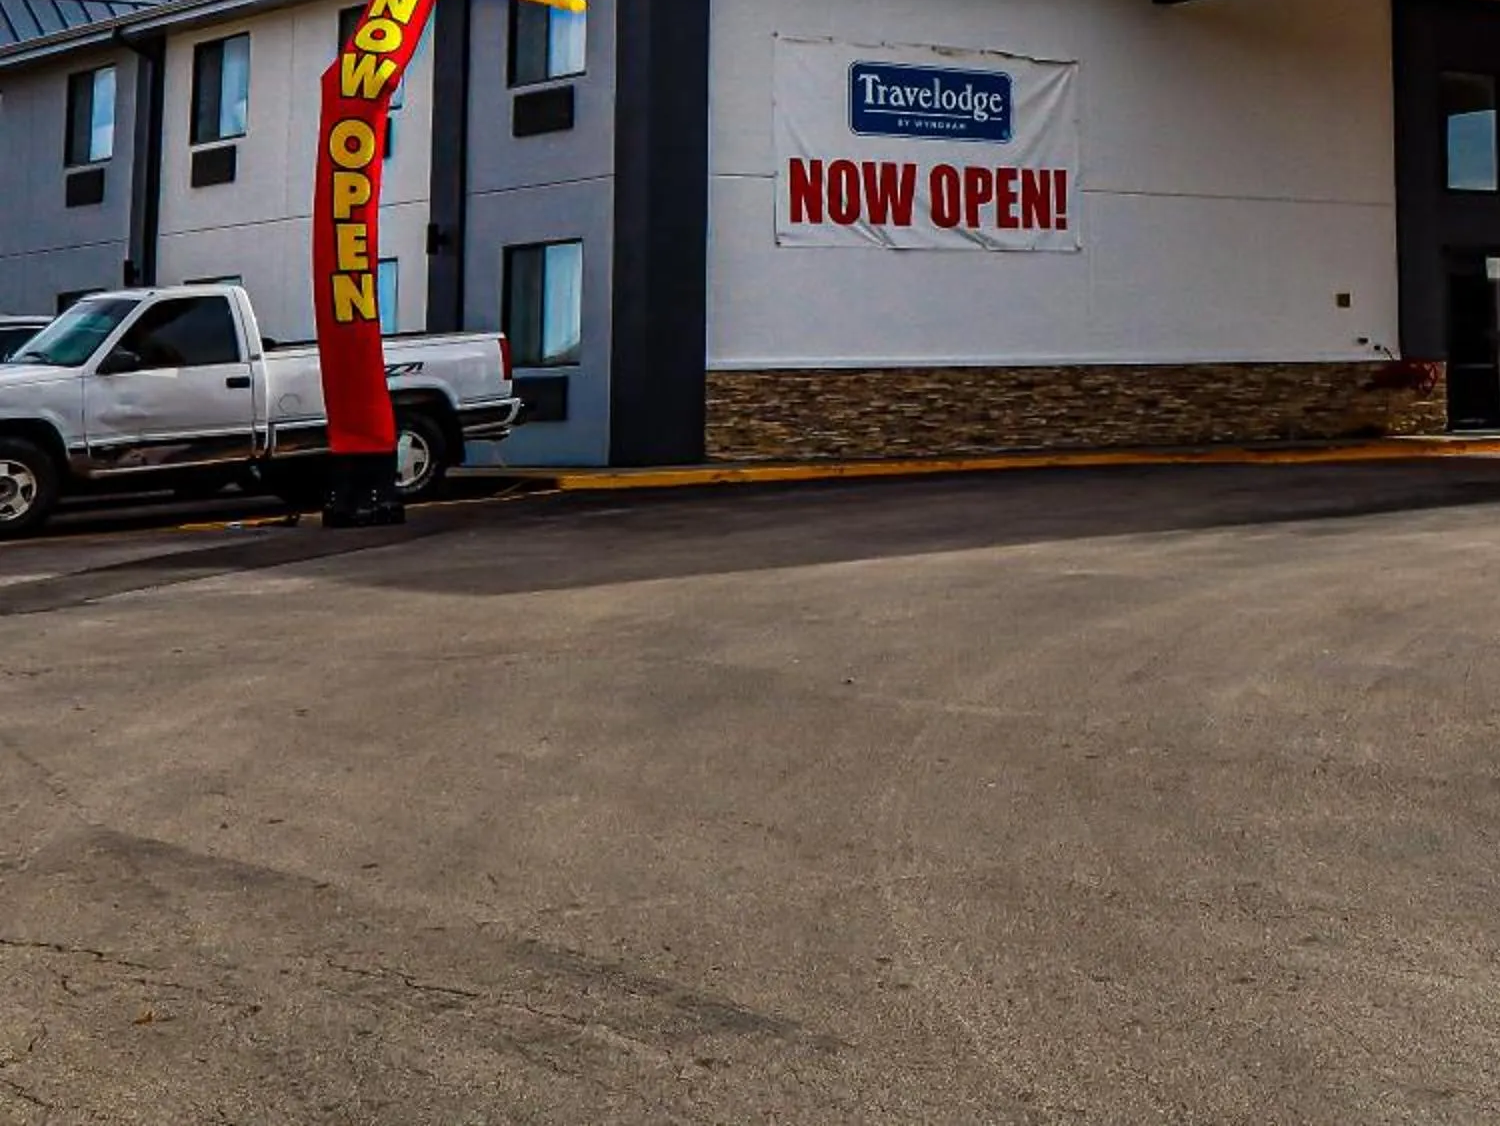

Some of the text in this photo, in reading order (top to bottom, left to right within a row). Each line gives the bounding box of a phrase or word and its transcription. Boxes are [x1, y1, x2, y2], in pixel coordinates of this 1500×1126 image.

[858, 73, 1003, 122] Travelodge
[328, 118, 377, 323] OPEN
[789, 157, 1068, 230] NOW OPEN!
